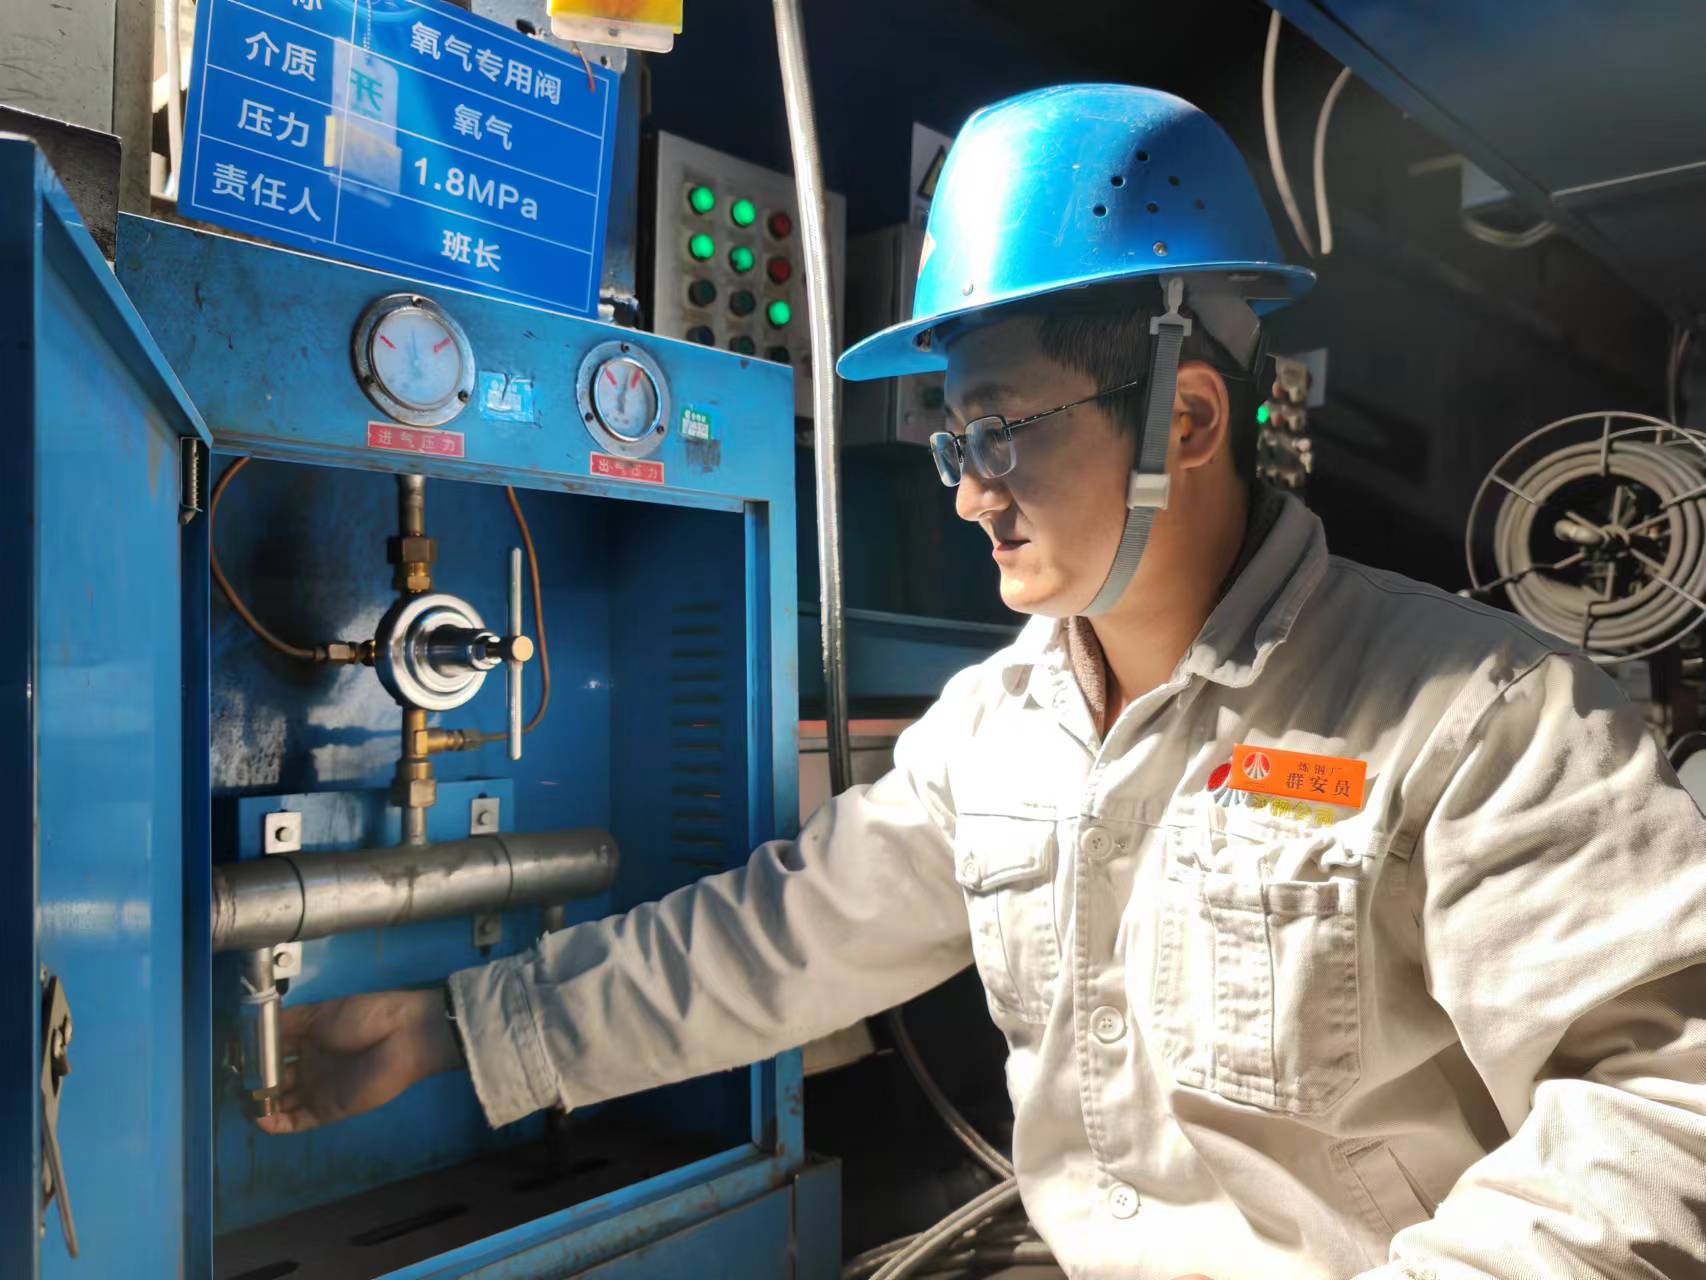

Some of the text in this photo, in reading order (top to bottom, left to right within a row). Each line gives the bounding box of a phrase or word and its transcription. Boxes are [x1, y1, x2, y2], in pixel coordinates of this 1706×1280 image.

[244, 31, 318, 82] 介质
[410, 21, 563, 106] 氧气专用阀
[237, 99, 311, 148] 压力
[453, 103, 513, 150] 氧气
[212, 163, 322, 223] 责任人
[413, 157, 539, 221] 1.8MPa
[442, 230, 500, 273] 班长
[1286, 772, 1351, 798] 群安员
